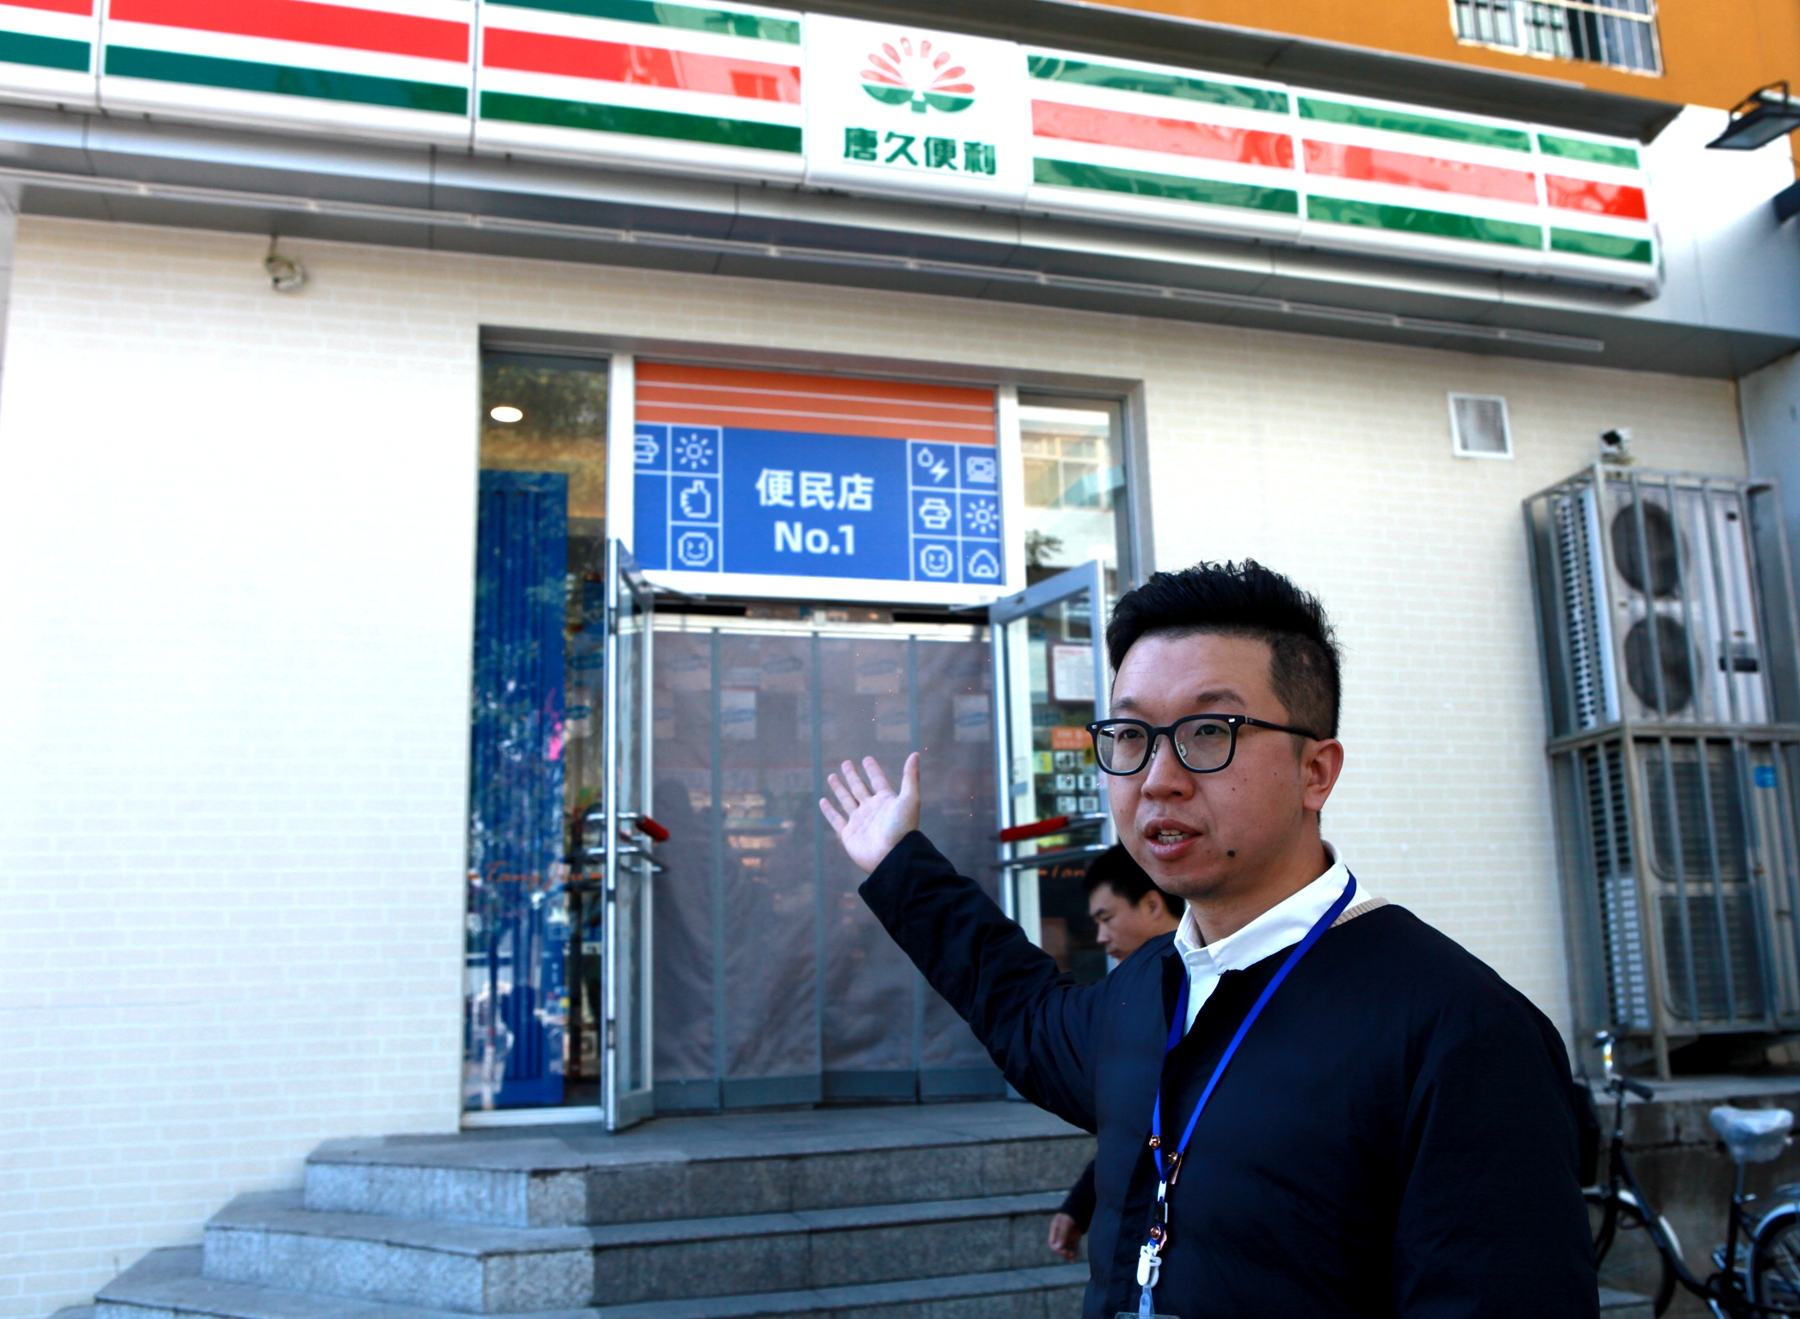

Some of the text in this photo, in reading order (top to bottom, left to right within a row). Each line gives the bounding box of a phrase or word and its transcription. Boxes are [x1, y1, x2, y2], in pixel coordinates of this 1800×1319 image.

[843, 127, 996, 175] 唐久便利
[755, 468, 874, 511] 便民店
[774, 521, 855, 555] No.1
